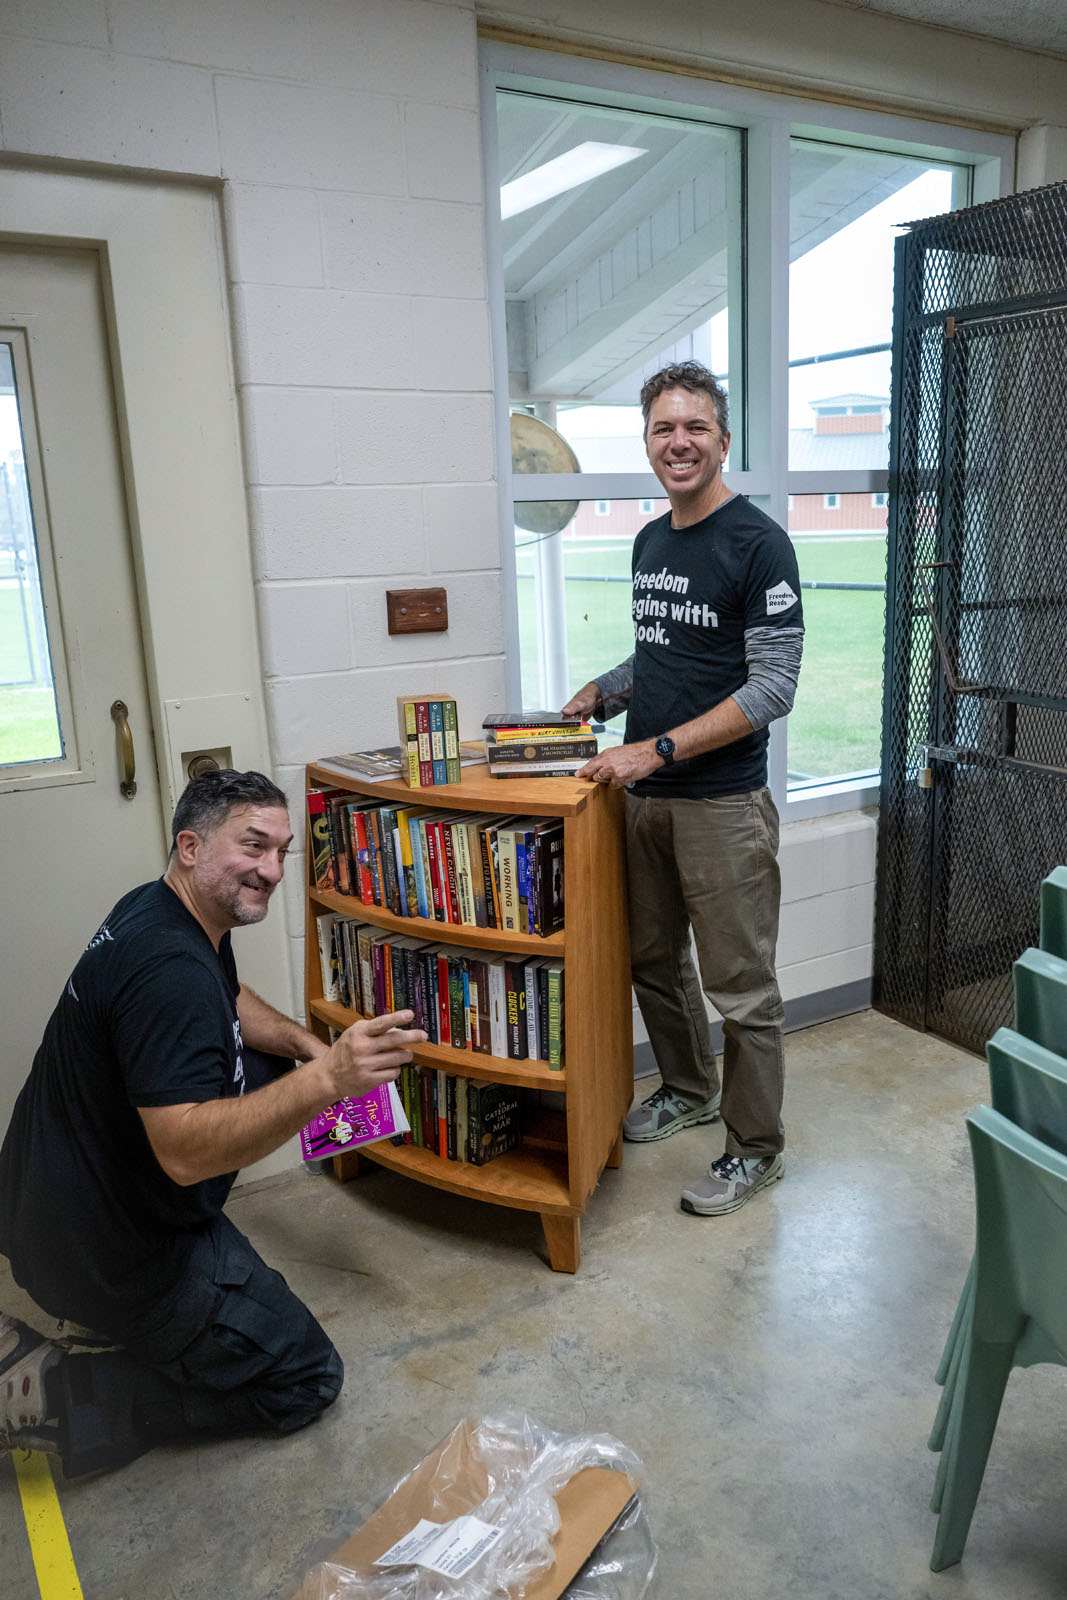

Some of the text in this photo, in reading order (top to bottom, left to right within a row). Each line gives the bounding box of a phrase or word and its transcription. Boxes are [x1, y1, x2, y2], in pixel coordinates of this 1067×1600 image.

[671, 600, 719, 628] with
[504, 858, 512, 907] WORKING
[508, 992, 518, 1025] CLOCKERS
[365, 1101, 378, 1120] The
[485, 1101, 518, 1121] CATEDRAL
[493, 1118, 510, 1132] MAR
